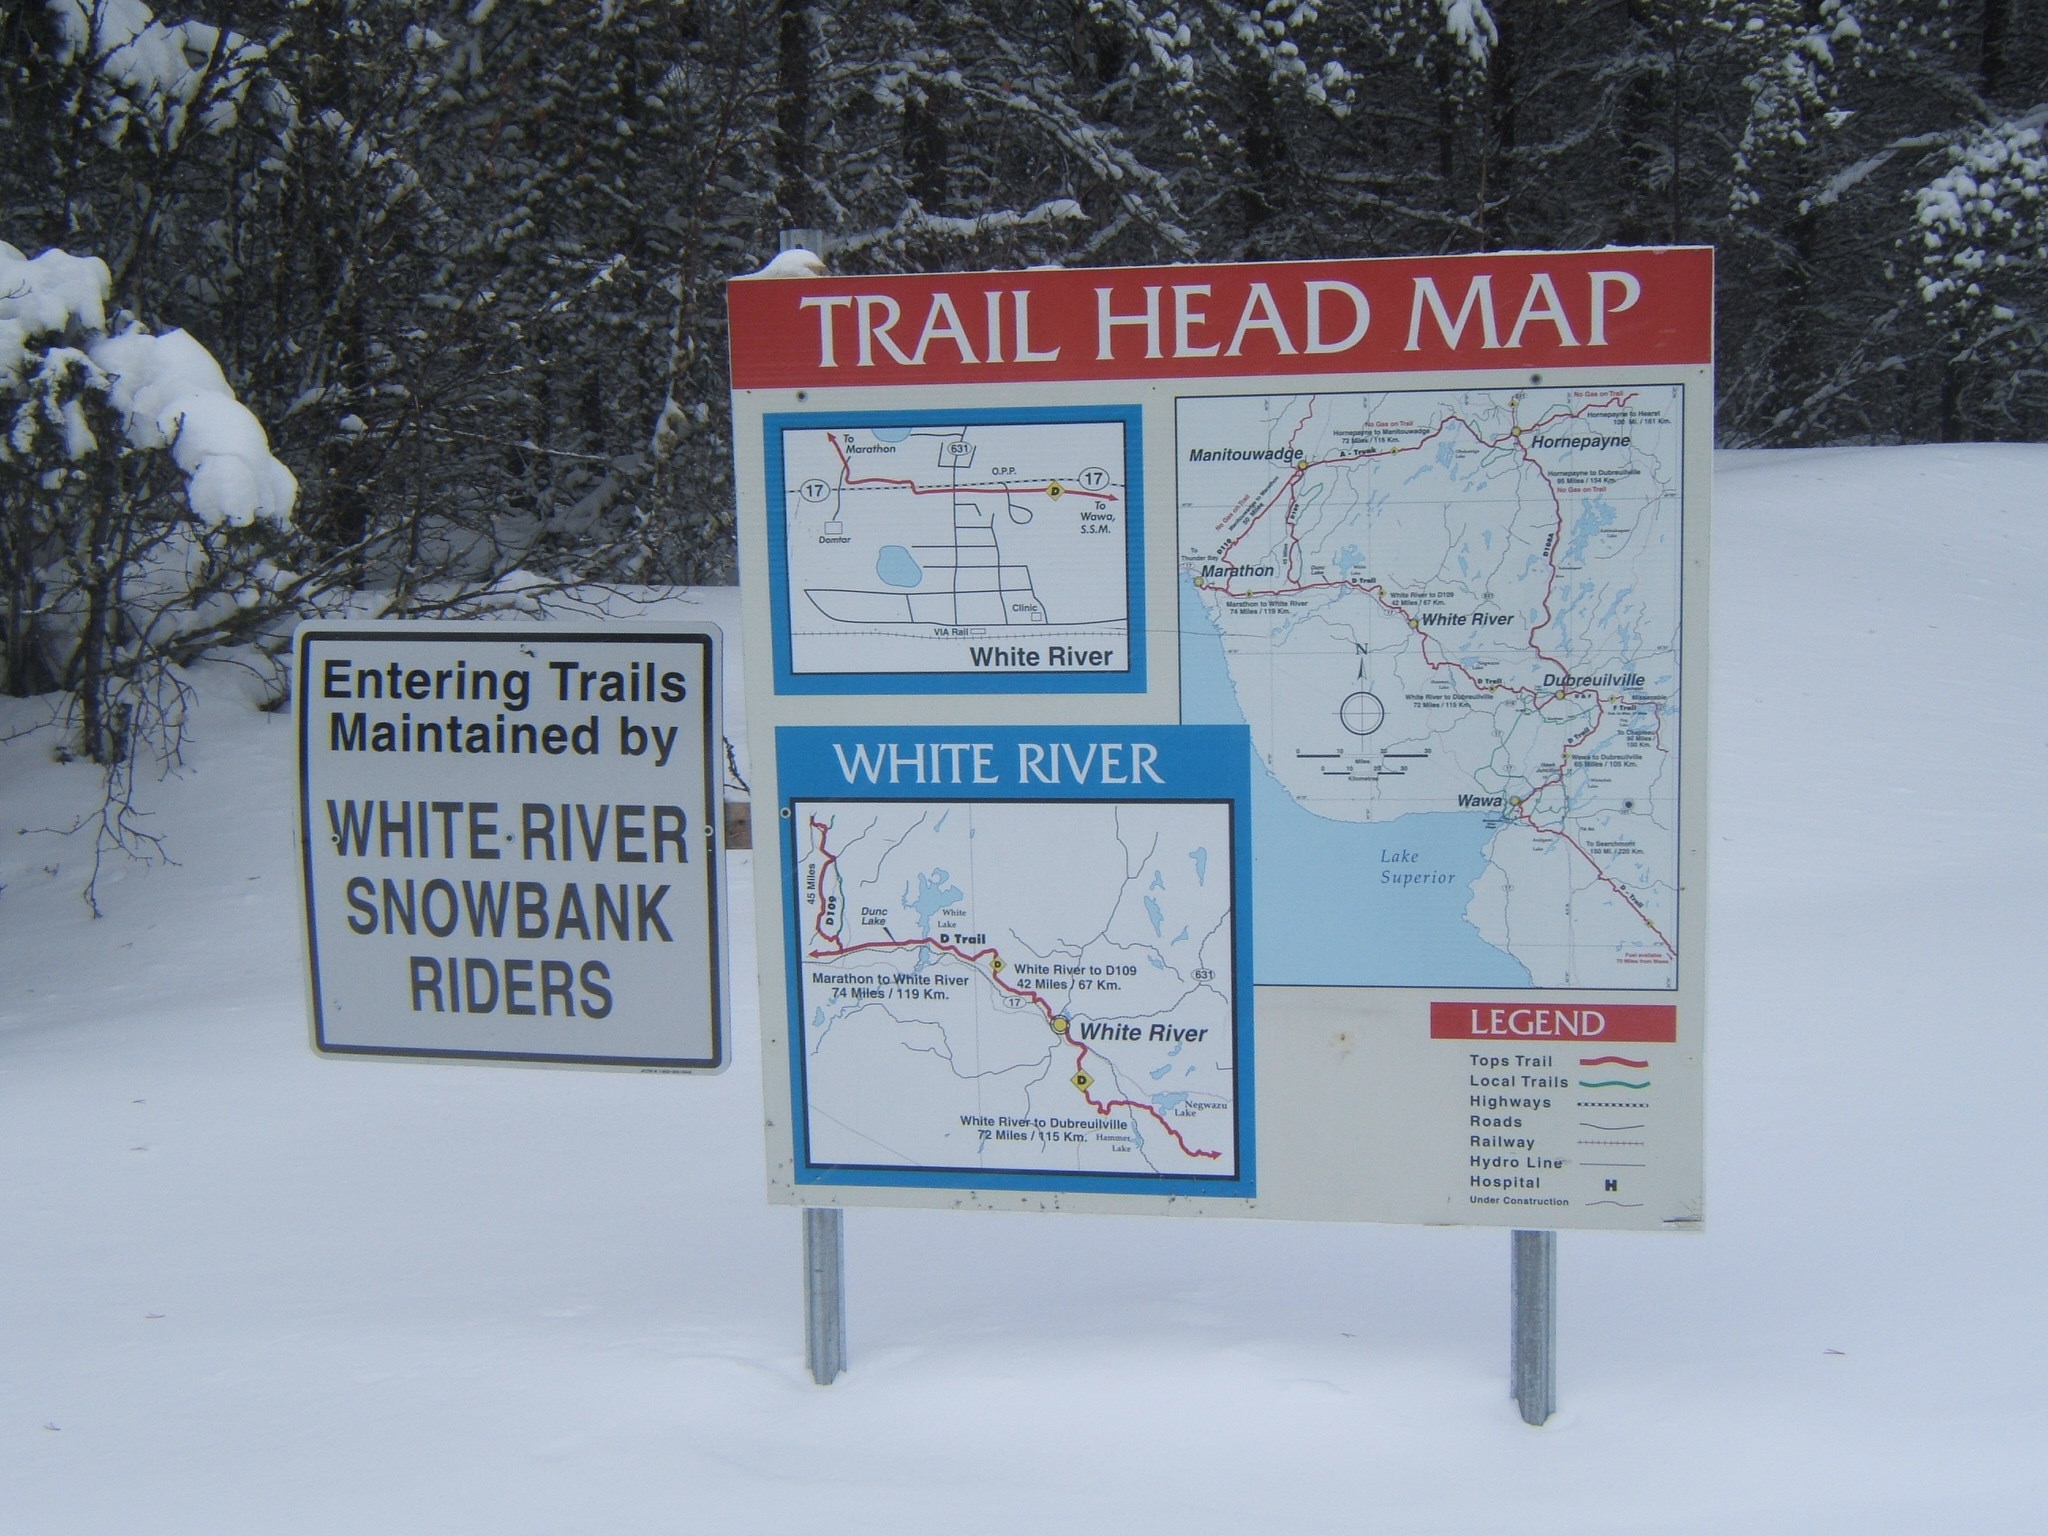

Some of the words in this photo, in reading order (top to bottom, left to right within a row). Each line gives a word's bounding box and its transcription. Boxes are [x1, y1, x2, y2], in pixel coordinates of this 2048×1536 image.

[800, 291, 1060, 367] TRAIL
[1093, 279, 1370, 361] HEAD
[1404, 270, 1640, 351] MAP
[843, 434, 854, 443] To
[1532, 435, 1631, 450] Hornepayne
[846, 444, 896, 454] Marathon
[951, 444, 969, 453] 631
[1189, 449, 1304, 463] Manitouwadge
[992, 467, 1016, 475] O.P.P.
[1085, 473, 1103, 485] 17
[805, 485, 824, 497] 17
[1094, 501, 1106, 510] To
[1080, 512, 1115, 522] Wawa,
[1080, 525, 1111, 534] S.S.M.
[1201, 565, 1274, 577] Marathon
[1012, 604, 1037, 612] Clinic
[1422, 613, 1466, 625] White
[1472, 613, 1514, 625] River
[954, 628, 968, 636] Rail
[1356, 643, 1368, 655] N
[970, 647, 1040, 666] White
[1049, 647, 1113, 666] River
[324, 659, 530, 710] Entering
[550, 661, 686, 702] Trails
[1543, 674, 1645, 686] Dubreuilville
[331, 712, 598, 754] Maintained
[621, 715, 678, 766] by
[832, 744, 999, 784] WHITE
[1018, 744, 1166, 784] RIVER
[1458, 794, 1502, 807] Wawa
[327, 800, 500, 859] WHITE
[522, 803, 688, 863] RIVER
[1381, 850, 1418, 862] Lake
[807, 863, 815, 891] Miles
[1381, 871, 1455, 887] Superior
[807, 893, 815, 904] 45
[347, 877, 673, 942] SNOWBANK
[826, 895, 836, 925] D109
[861, 917, 885, 925] Lake
[941, 935, 949, 943] D
[955, 935, 986, 944] Trail
[1014, 964, 1049, 975] White
[1053, 965, 1087, 975] River
[1090, 966, 1102, 975] to
[1106, 966, 1136, 976] D109
[812, 973, 875, 984] Marathon
[878, 975, 890, 984] to
[893, 974, 932, 985] White
[935, 975, 969, 986] River
[1017, 979, 1031, 989] 42
[1035, 979, 1068, 989] Miles
[1078, 980, 1092, 990] 67
[1099, 981, 1121, 990] Km.
[410, 956, 613, 1019] RIDERS
[832, 988, 847, 998] 74
[851, 988, 884, 998] Miles
[897, 989, 919, 999] 119
[924, 990, 949, 1000] Km.
[1010, 998, 1020, 1006] 17
[1471, 1009, 1605, 1036] LEGEND
[1080, 1023, 1142, 1041] White
[1150, 1024, 1208, 1042] River
[1470, 1055, 1509, 1067] Tops
[1516, 1056, 1552, 1067] Trail
[1078, 1076, 1087, 1084] D
[1470, 1075, 1515, 1087] Local
[1521, 1076, 1568, 1088] Trails
[1185, 1101, 1227, 1110] Negwazu
[1470, 1096, 1551, 1110] Highways
[1174, 1109, 1197, 1117] Lake
[961, 1117, 995, 1127] White
[999, 1118, 1031, 1128] River
[1034, 1119, 1047, 1128] to
[1051, 1118, 1127, 1130] Dubreuilville
[1470, 1116, 1522, 1127] Roads
[978, 1130, 992, 1140] 72
[996, 1130, 1028, 1140] Miles
[1039, 1131, 1060, 1141] 115
[1064, 1132, 1087, 1142] Km.
[1470, 1136, 1534, 1150] Railway
[1470, 1156, 1520, 1170] Hydro
[1527, 1157, 1562, 1168] Line
[1470, 1176, 1540, 1190] Hospital
[1605, 1180, 1617, 1191] H
[1503, 1197, 1569, 1206] Construction
